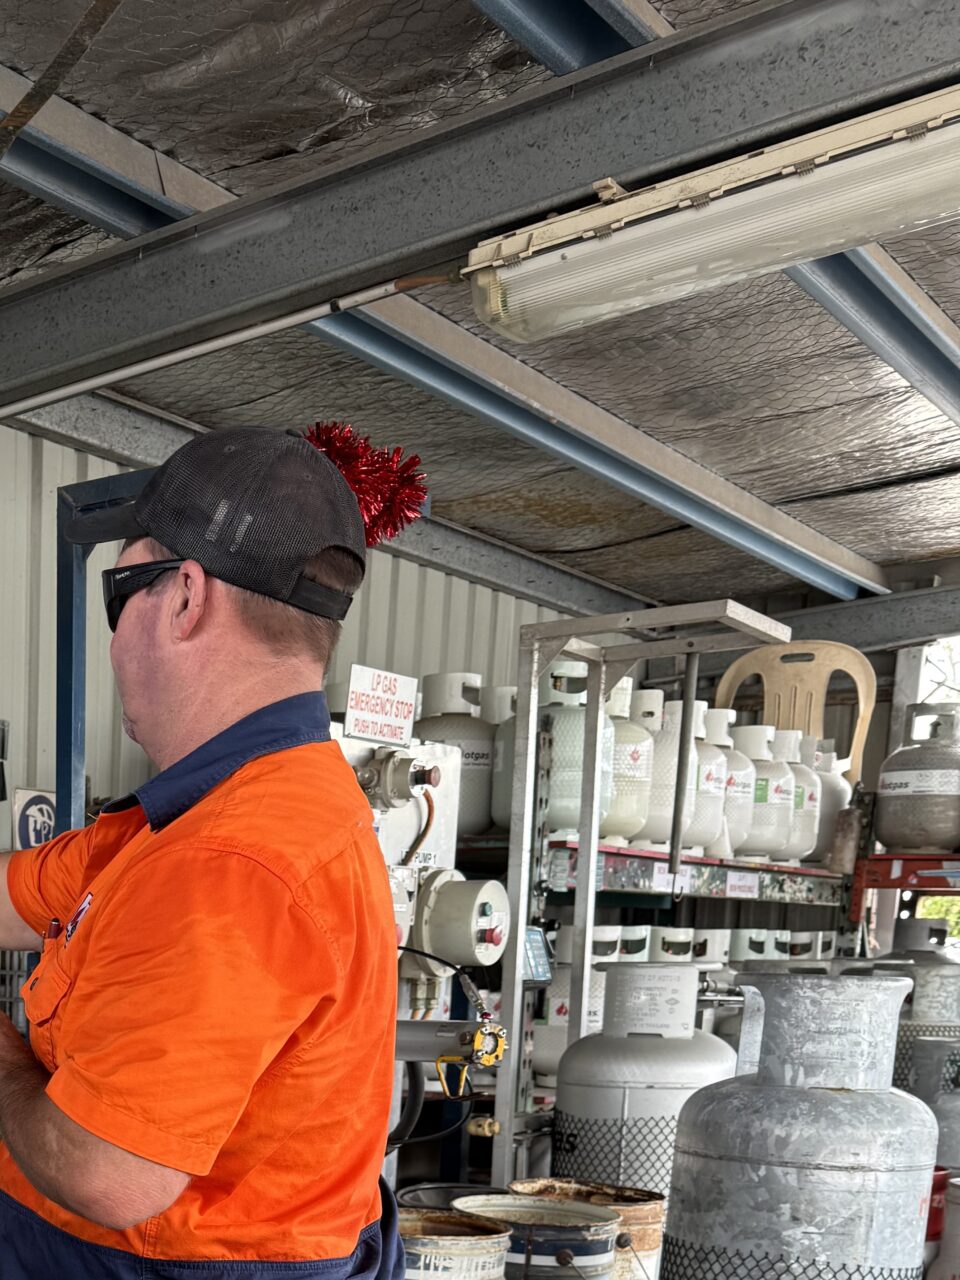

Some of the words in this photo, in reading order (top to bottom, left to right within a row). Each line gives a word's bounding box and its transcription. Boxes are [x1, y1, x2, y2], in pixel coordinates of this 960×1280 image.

[371, 673, 381, 691] LP
[382, 675, 397, 696] GAS
[349, 690, 394, 717] EMERGENCY
[395, 700, 413, 720] STOP
[354, 718, 369, 734] PUSH
[371, 721, 378, 736] TO
[378, 723, 405, 740] ACTIVATE
[461, 750, 489, 761] otgas
[414, 850, 432, 864] PUMP
[433, 851, 437, 864] 1
